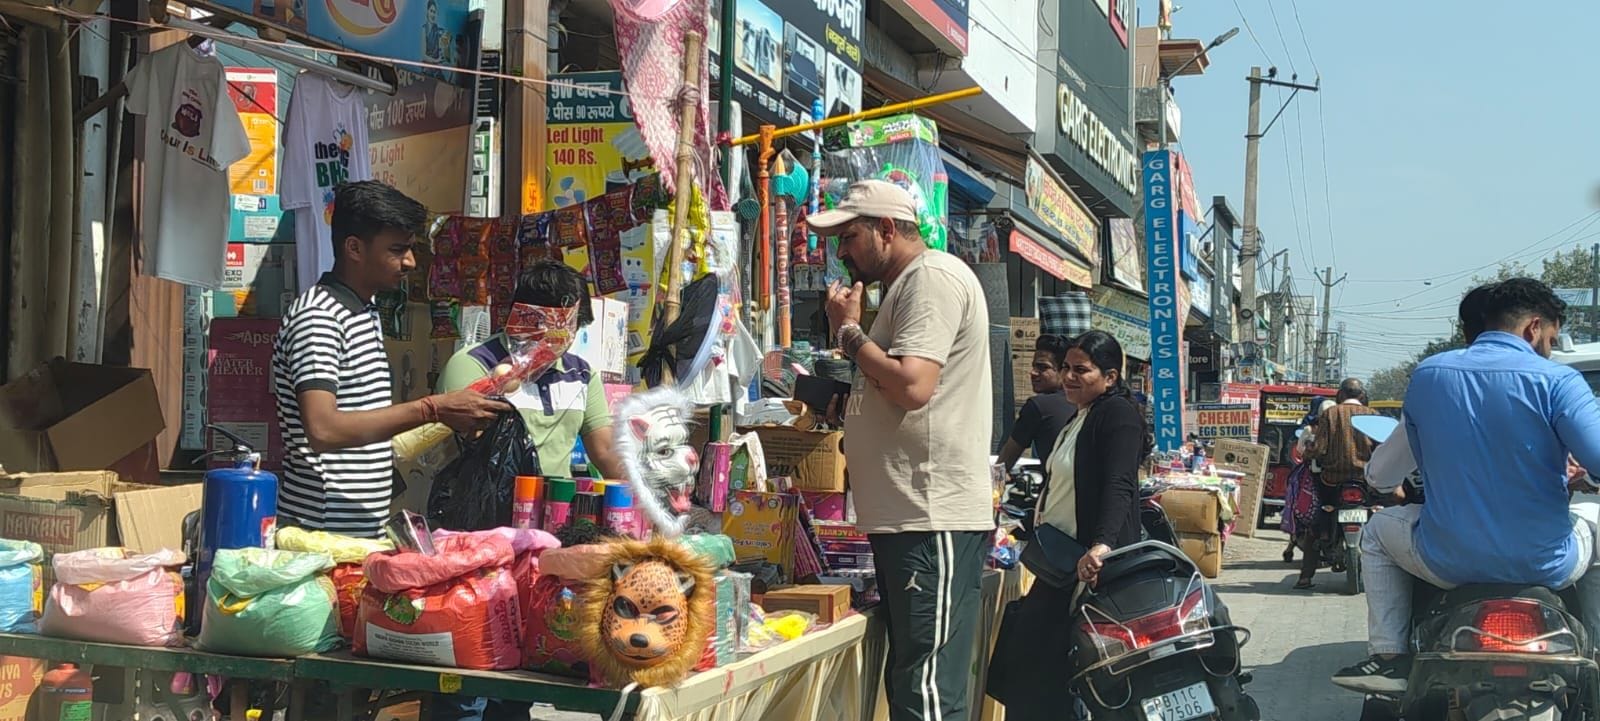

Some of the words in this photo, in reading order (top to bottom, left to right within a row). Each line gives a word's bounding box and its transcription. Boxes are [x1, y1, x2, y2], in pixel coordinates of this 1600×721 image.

[387, 99, 404, 126] 100
[553, 101, 574, 120] पीस
[576, 105, 585, 119] 90
[1058, 82, 1088, 150] GARG
[547, 127, 569, 144] Led
[572, 126, 604, 145] Light
[380, 143, 405, 166] Light
[553, 148, 576, 165] 140
[578, 148, 597, 165] Rs.
[1149, 159, 1166, 209] GARG
[1152, 217, 1173, 359] ELECTRONICS
[214, 367, 264, 376] HEATER
[1158, 368, 1175, 379] &
[1197, 411, 1249, 425] CHEEMA
[1198, 426, 1218, 437] EGG
[1220, 426, 1250, 436] STORE
[1236, 455, 1249, 465] LG
[1153, 686, 1198, 709] PB11C
